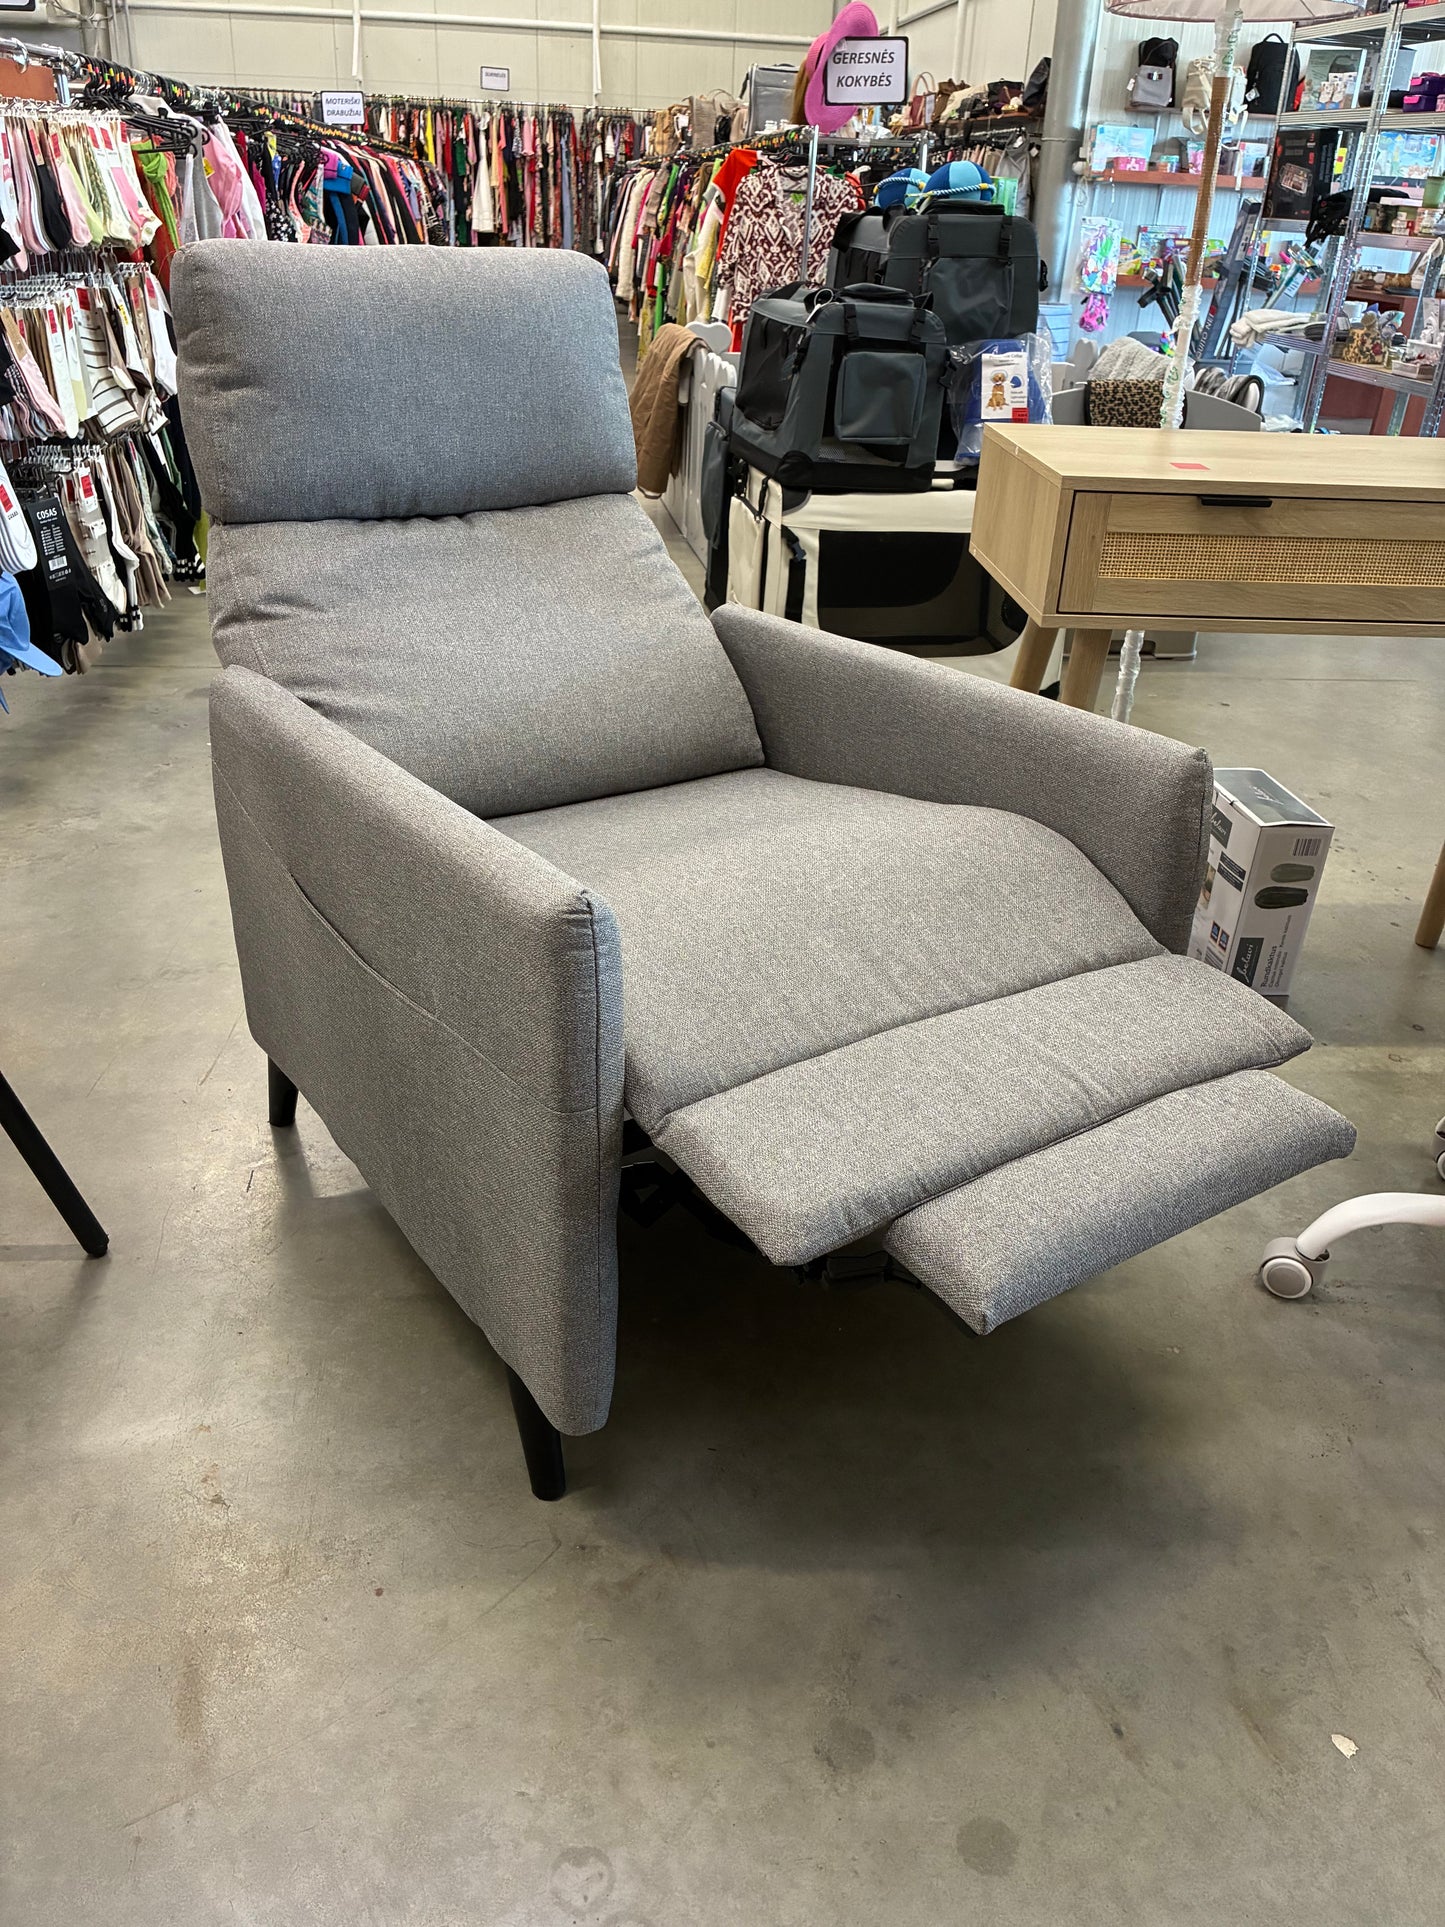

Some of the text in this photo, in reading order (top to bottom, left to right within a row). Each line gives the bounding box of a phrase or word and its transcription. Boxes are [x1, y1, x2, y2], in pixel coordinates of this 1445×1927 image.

[832, 49, 895, 64] GERESNĖS
[836, 72, 892, 87] KOKYBĖS
[325, 97, 361, 105] MOTERIŠKI
[326, 109, 362, 117] DRABUŽIAI
[36, 508, 58, 520] COSAS
[1236, 943, 1254, 983] belavi
[1260, 945, 1278, 988] Rundkaktus
